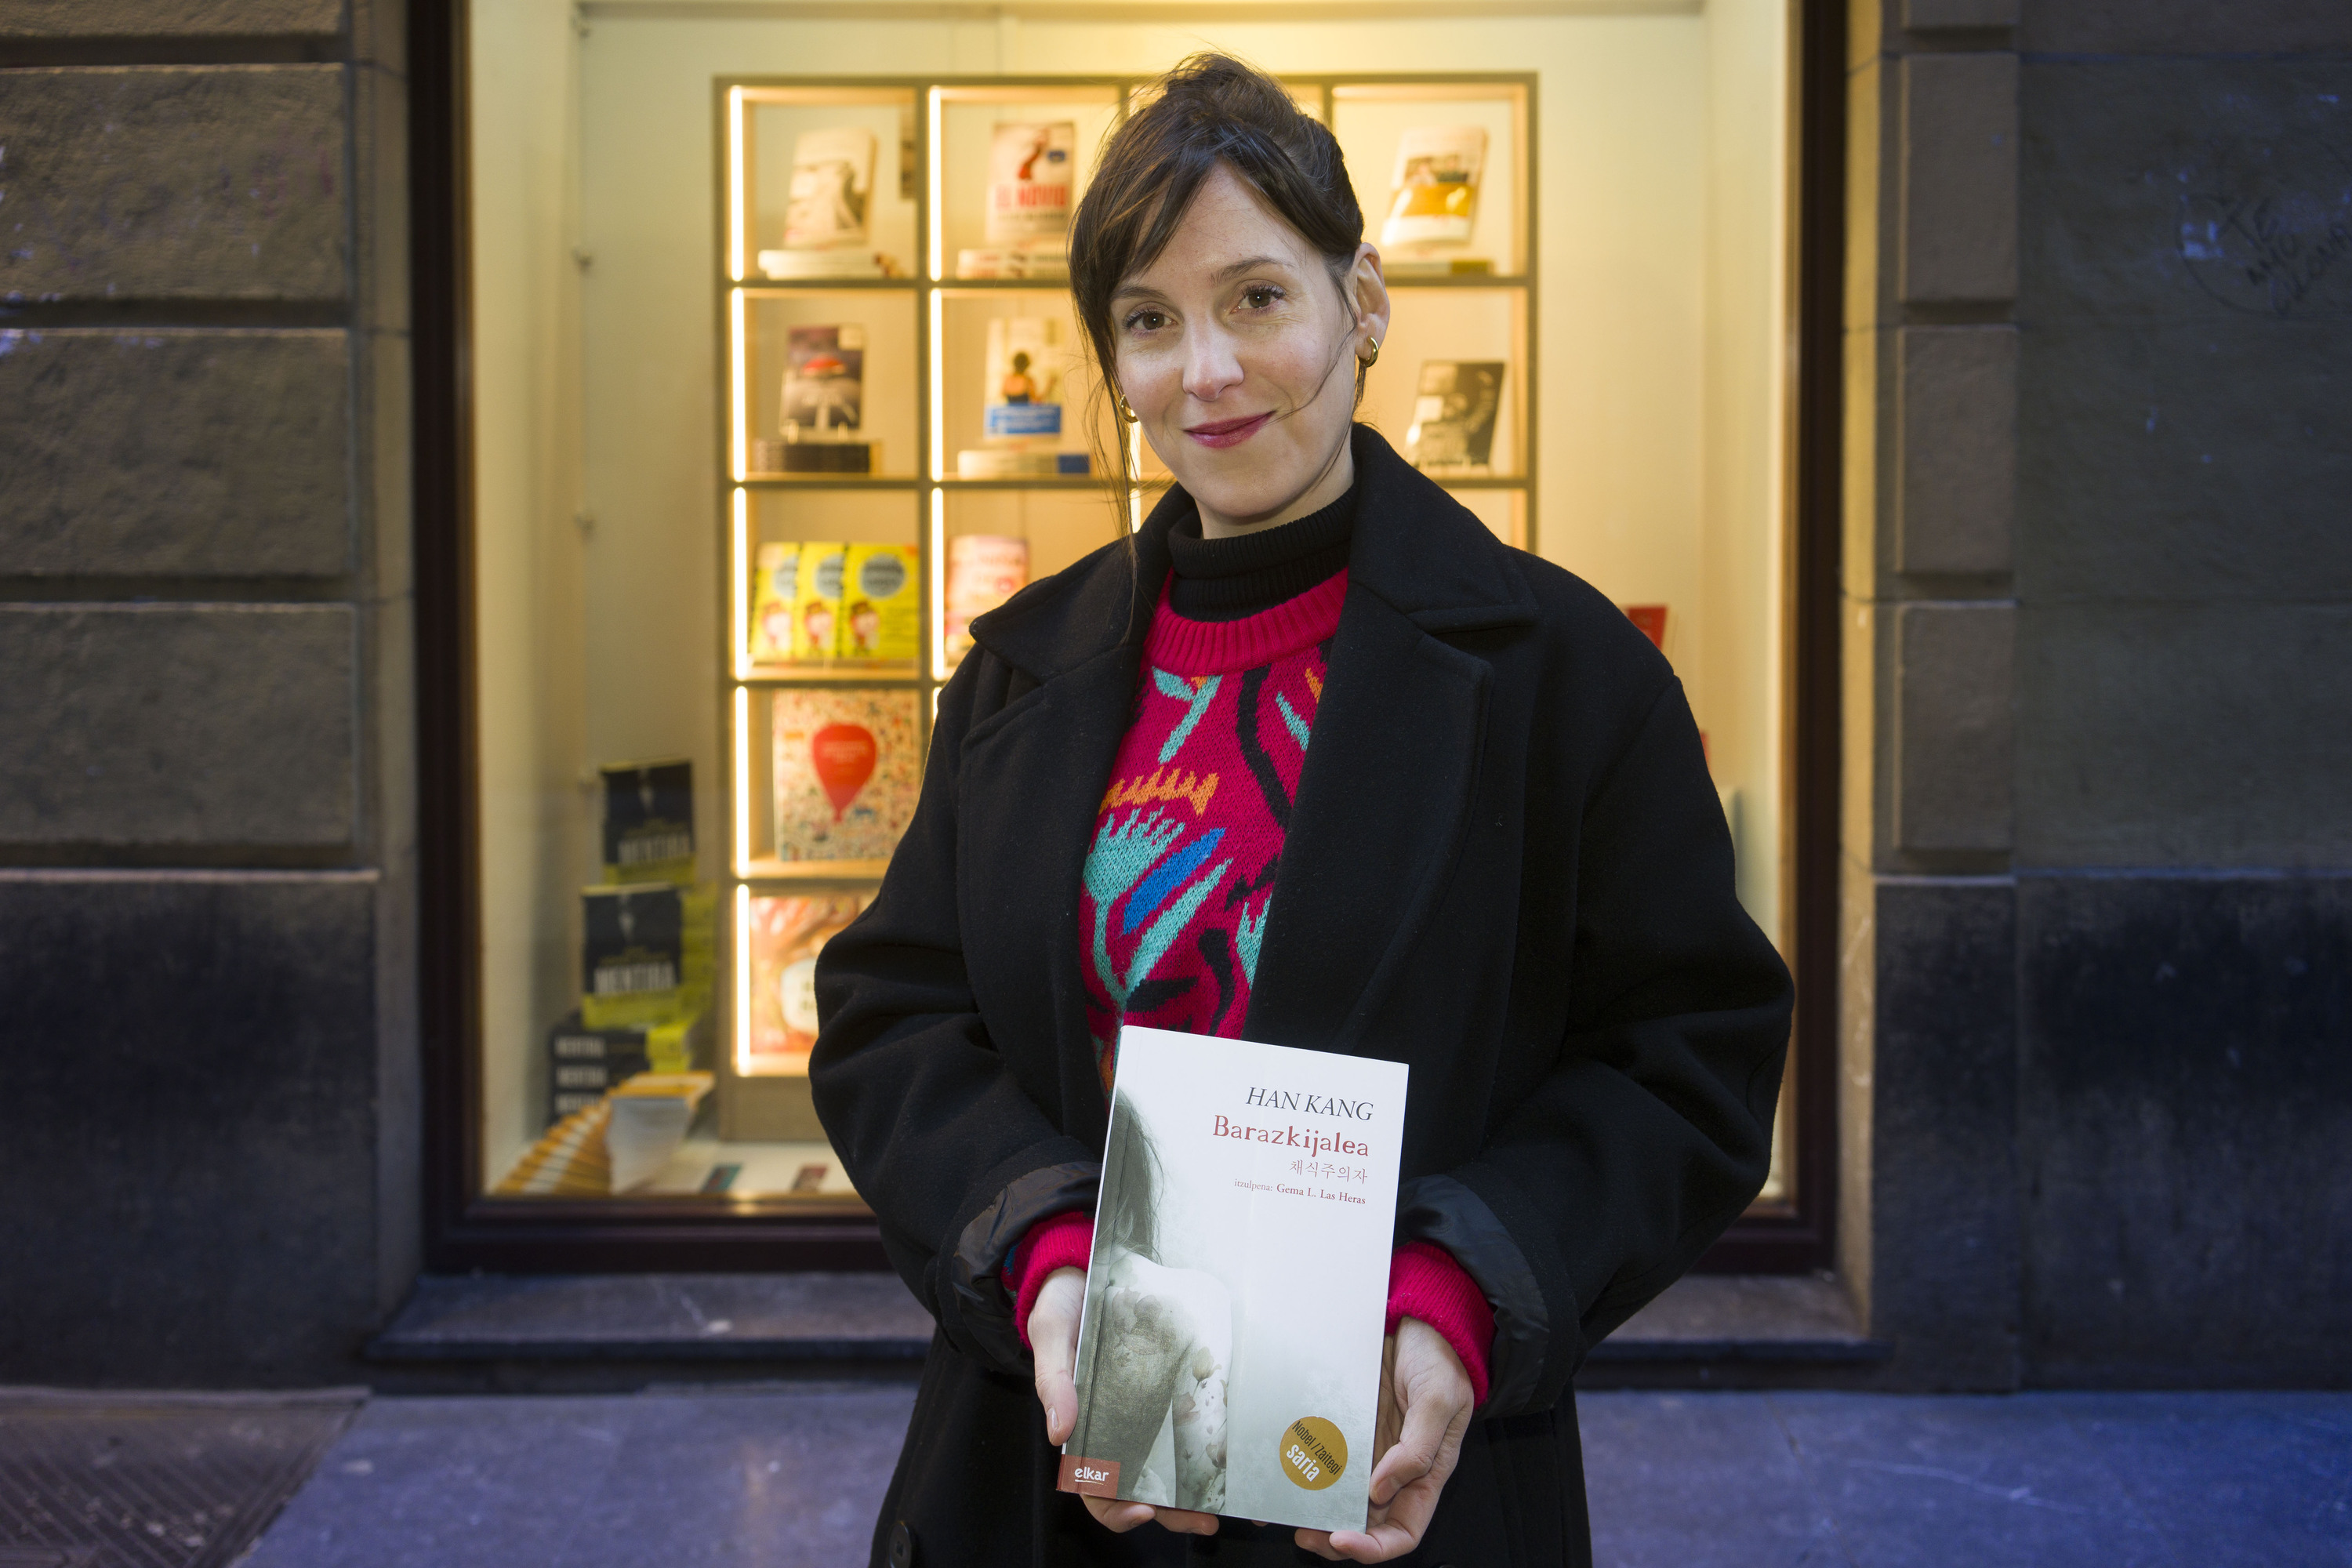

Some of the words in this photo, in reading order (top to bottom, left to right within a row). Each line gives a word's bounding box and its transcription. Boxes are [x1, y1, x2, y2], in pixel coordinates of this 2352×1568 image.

[1245, 1087, 1301, 1111] HAN
[1304, 1094, 1374, 1121] KANG
[1212, 1114, 1369, 1158] Barazkijalea
[1288, 1159, 1368, 1185] 채식주의자
[1234, 1178, 1273, 1192] itzulpena:
[1276, 1183, 1305, 1196] Gema
[1307, 1187, 1316, 1198] L.
[1319, 1189, 1336, 1200] Las
[1338, 1192, 1367, 1205] Heras
[1286, 1444, 1320, 1482] saria
[1292, 1421, 1316, 1447] Nobel
[1314, 1445, 1343, 1475] Zaitegi
[1074, 1466, 1109, 1482] elkar
